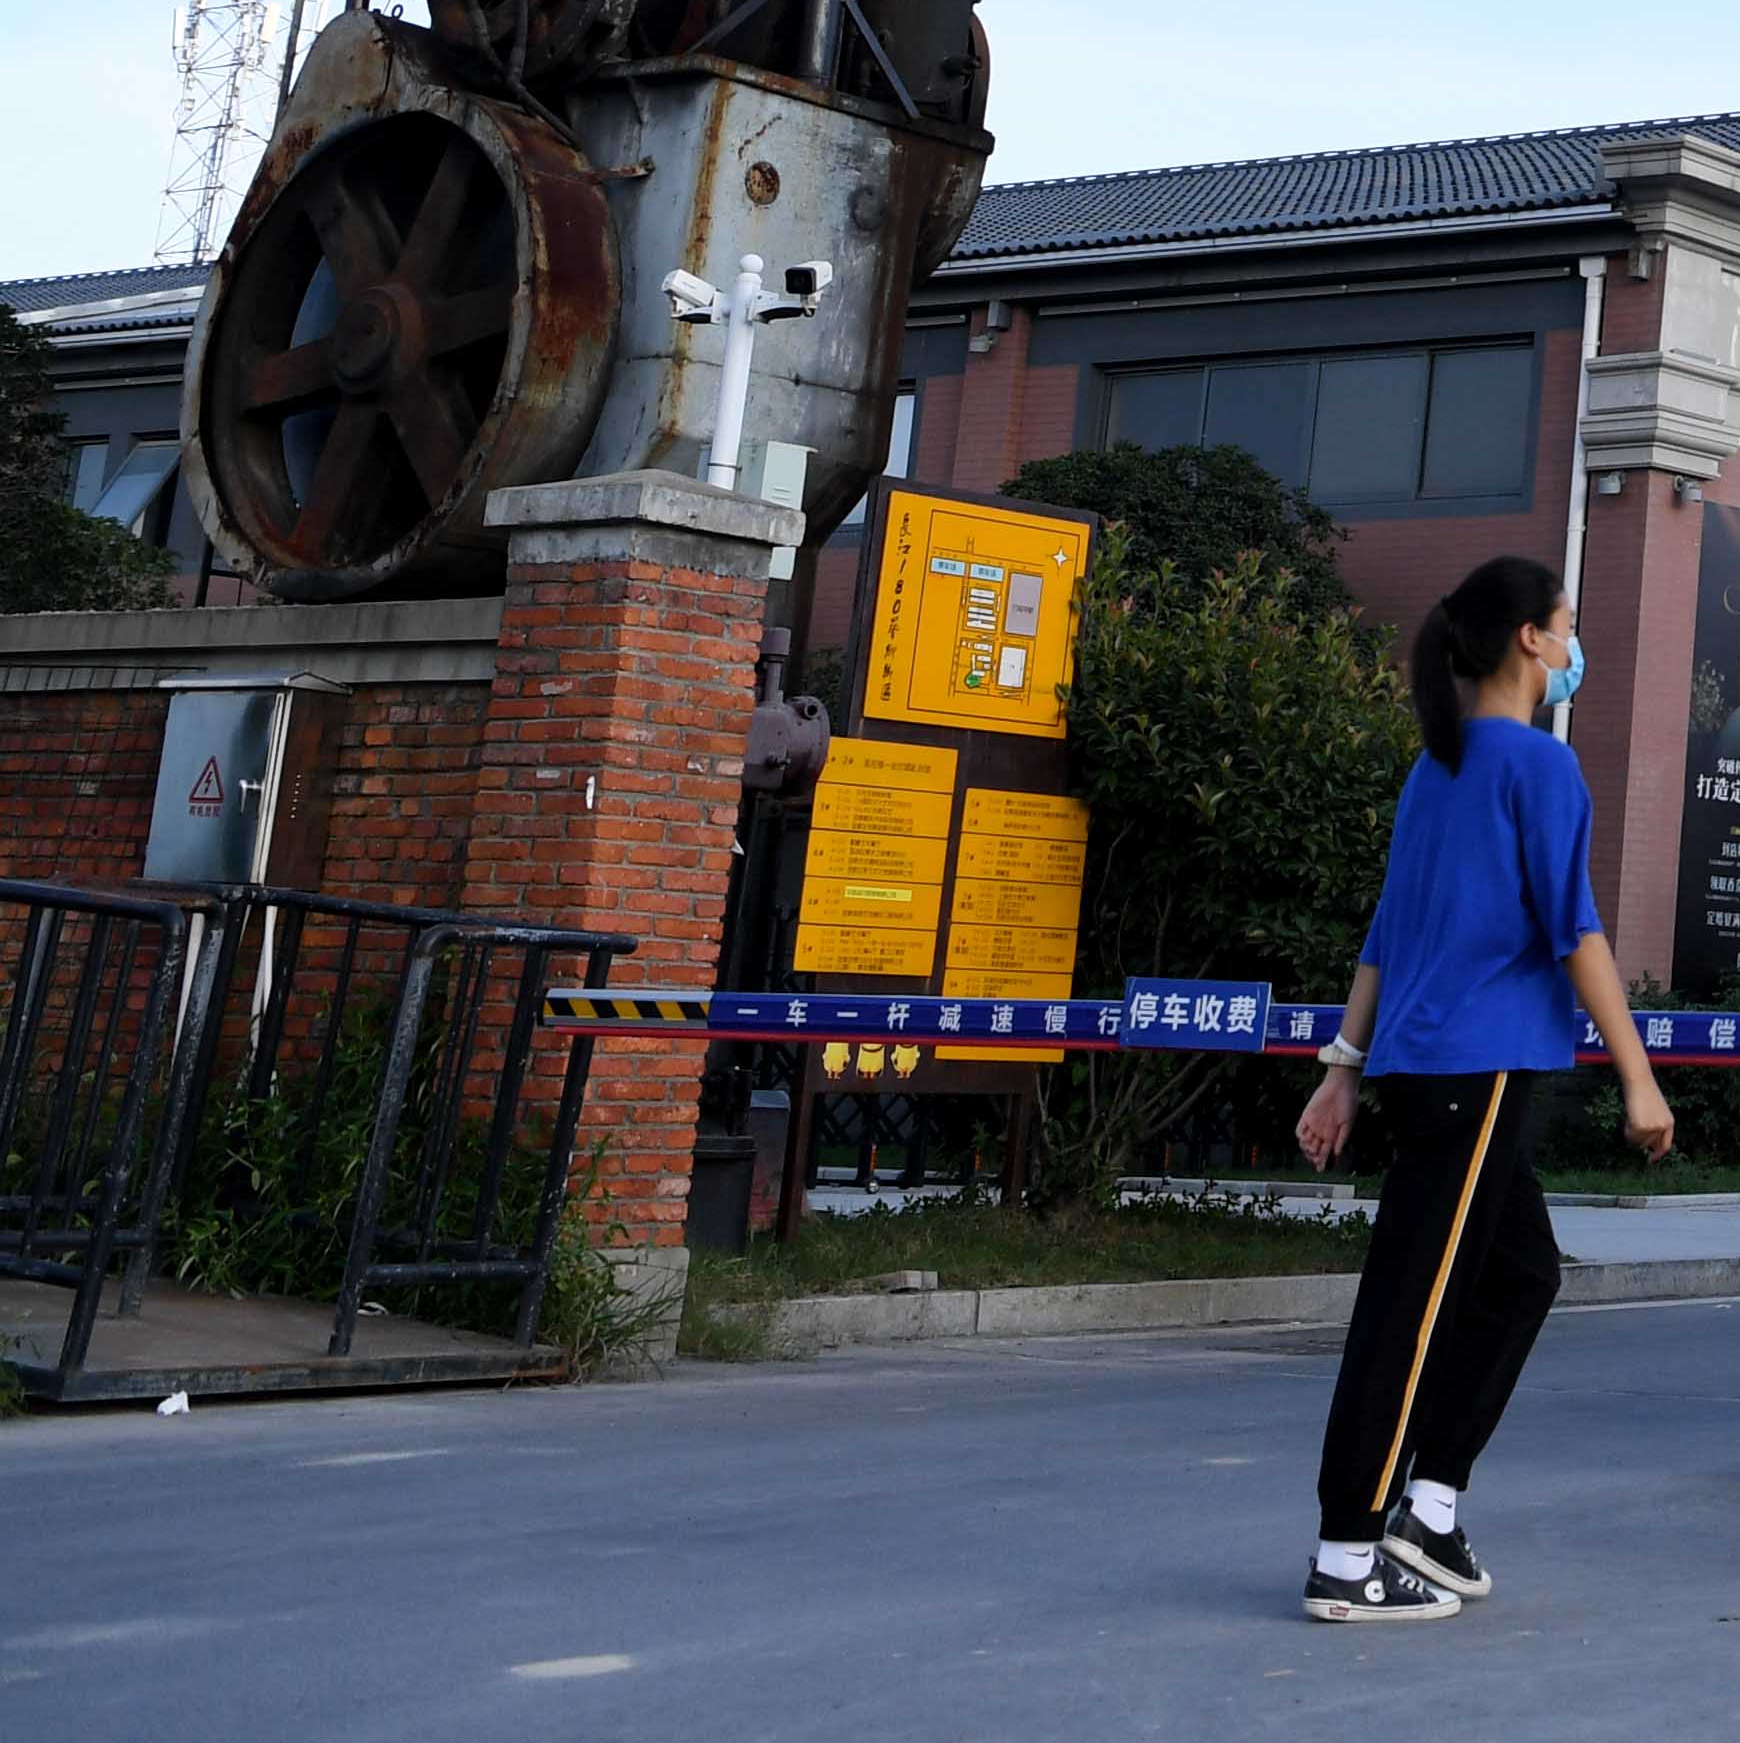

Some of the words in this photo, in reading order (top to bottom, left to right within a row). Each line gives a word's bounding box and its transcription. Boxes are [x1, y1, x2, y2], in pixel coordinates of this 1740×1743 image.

[736, 999, 1126, 1036] 一车一杆减速慢行
[1129, 991, 1257, 1036] 停车收费
